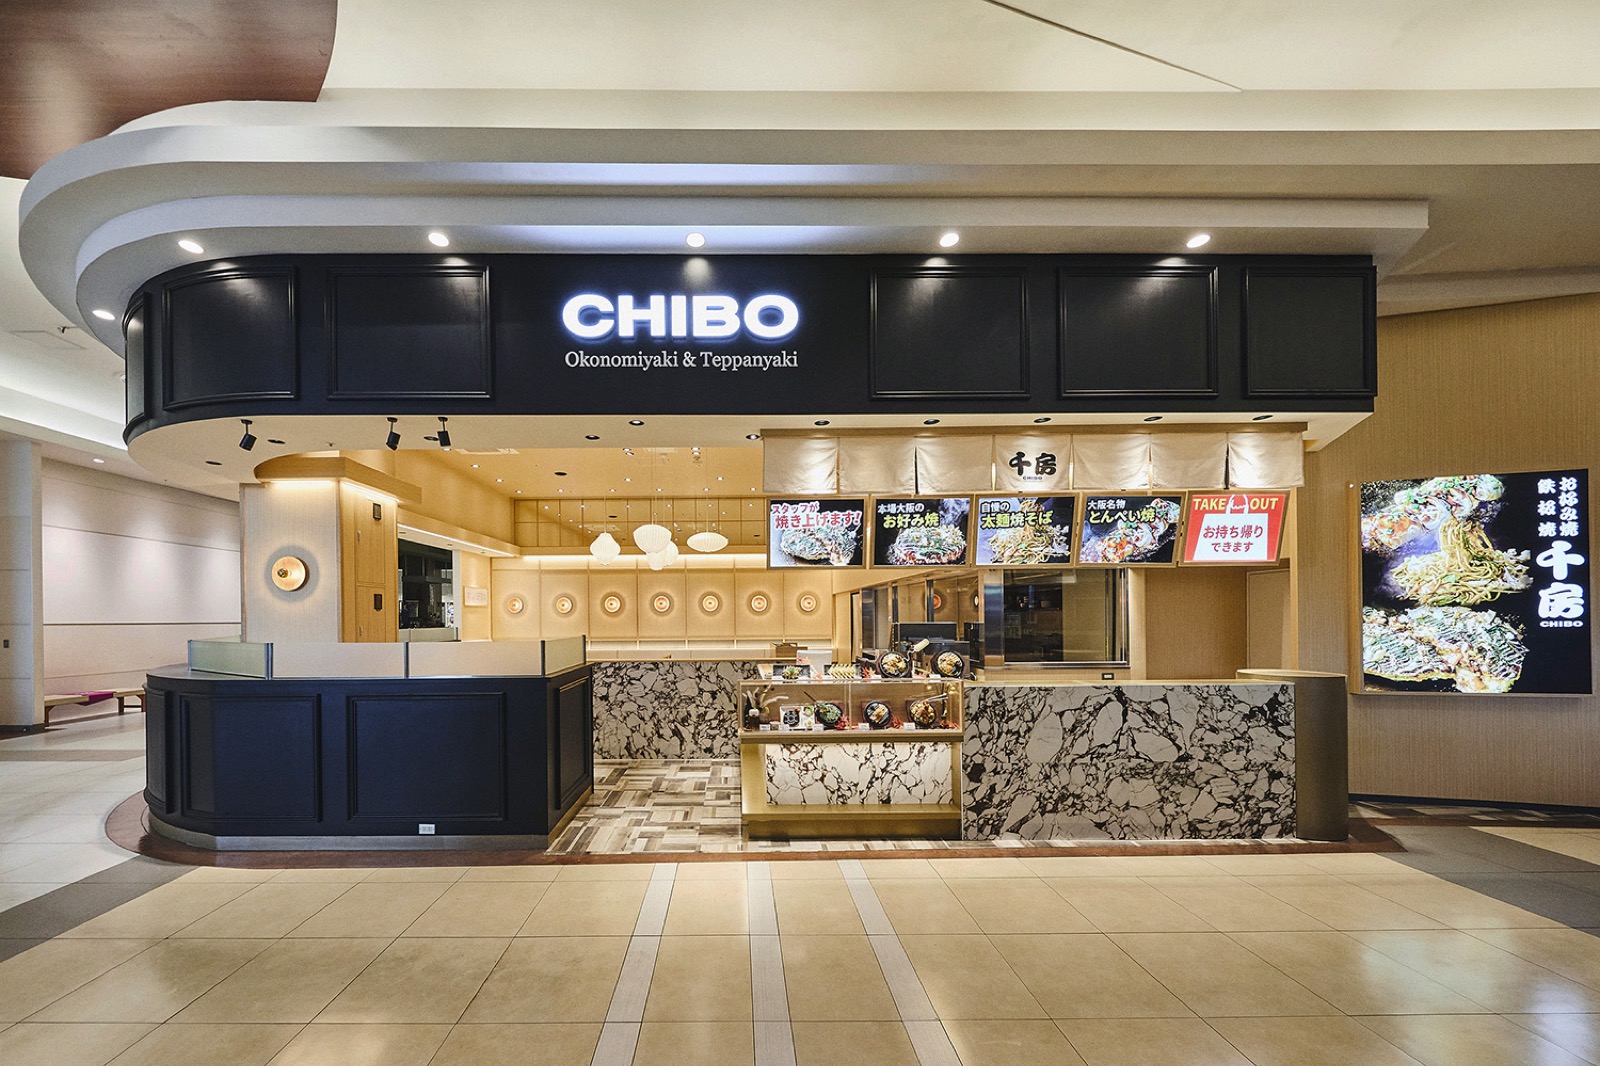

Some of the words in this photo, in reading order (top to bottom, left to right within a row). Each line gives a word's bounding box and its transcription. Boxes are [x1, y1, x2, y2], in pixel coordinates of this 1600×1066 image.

[561, 294, 799, 340] CHIBO
[564, 350, 679, 371] Okonomiyaki
[682, 351, 697, 367] &
[700, 350, 798, 371] Teppanyaki
[1008, 451, 1057, 475] 千房
[771, 502, 819, 515] スタッフが
[877, 503, 925, 514] 本場大阪の
[981, 502, 1010, 513] 自慢の
[1087, 499, 1126, 510] 大阪名物
[1193, 498, 1227, 511] TAKE
[1249, 497, 1279, 510] OUT
[1537, 478, 1557, 537] 鉄板焼
[1558, 476, 1579, 537] お好み焼
[883, 512, 940, 528] お好み焼
[981, 510, 1054, 528] 太麺焼そば
[1089, 508, 1156, 524] とんぺい焼
[1202, 525, 1264, 539] お持ち帰り
[1211, 541, 1254, 553] できます
[1536, 540, 1585, 618] 千房
[1539, 620, 1584, 628] CHIBO
